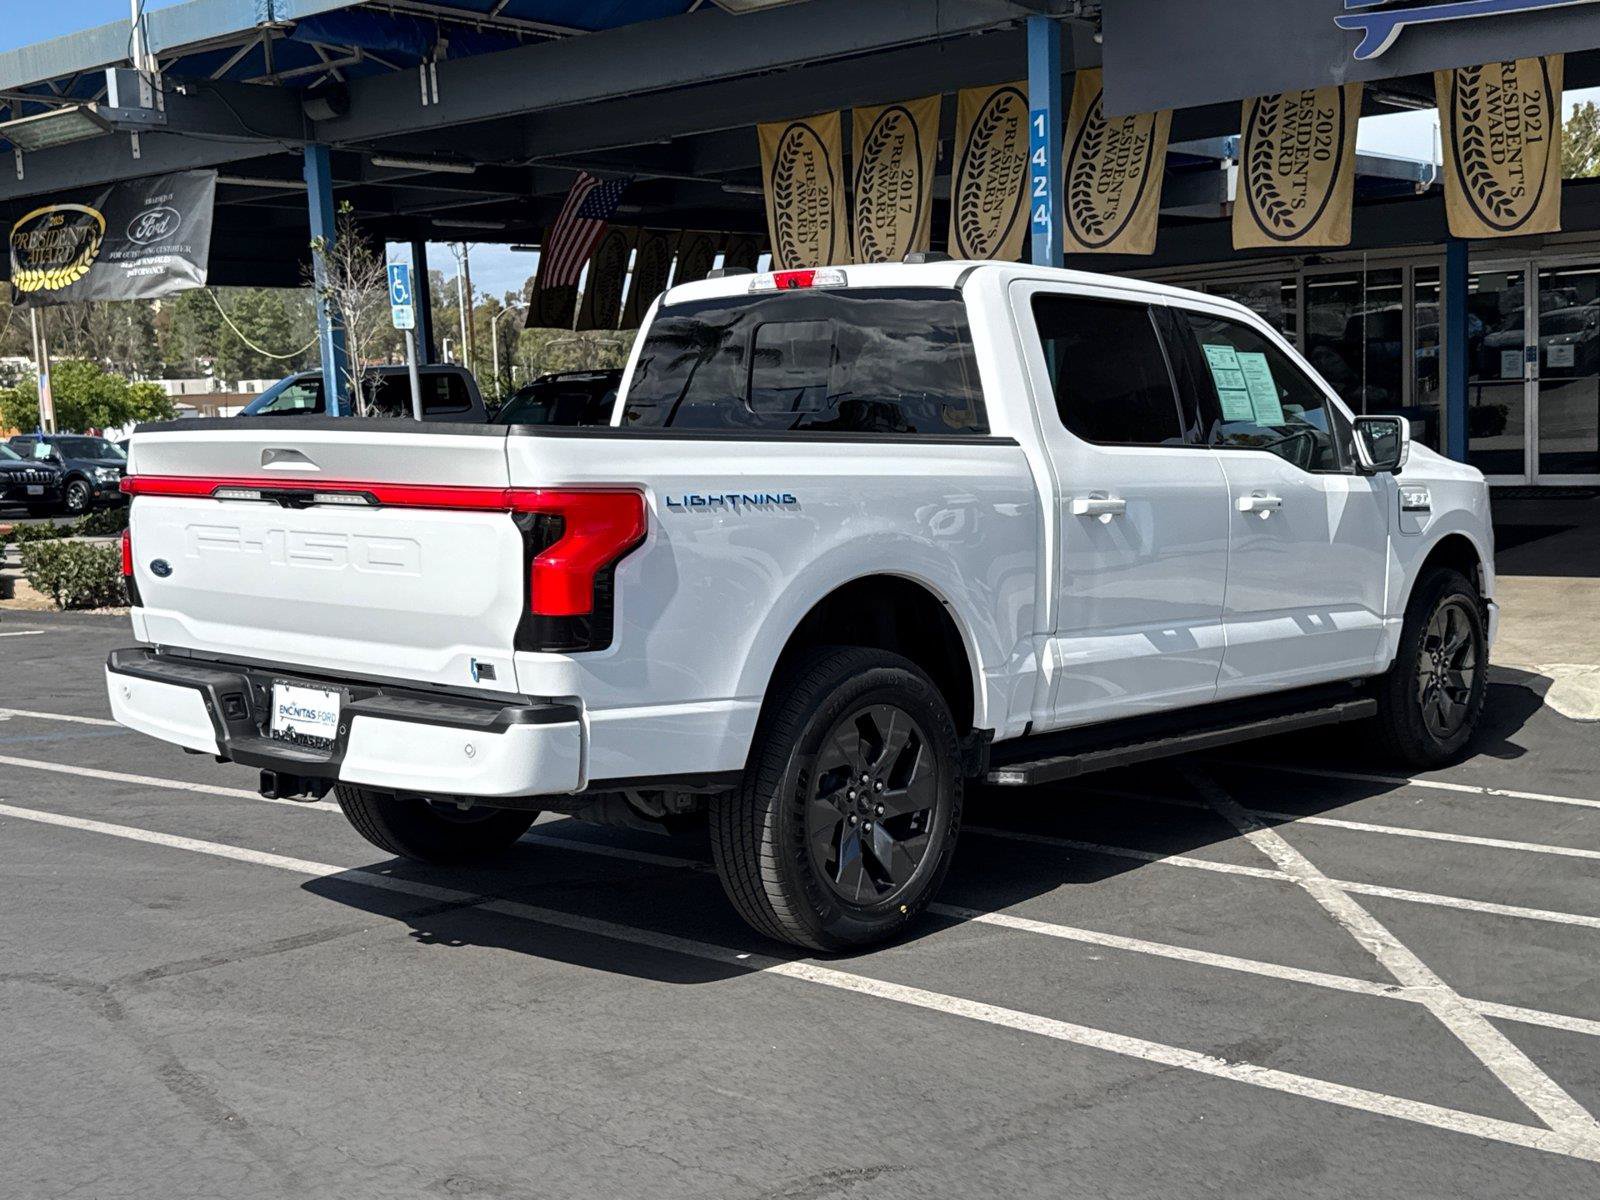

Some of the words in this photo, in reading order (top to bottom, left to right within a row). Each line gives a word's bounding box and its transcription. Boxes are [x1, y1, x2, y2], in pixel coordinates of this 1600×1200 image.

[1278, 100, 1298, 177] AWARD
[1313, 108, 1334, 161] 2020
[1485, 82, 1505, 165] AWARD
[1500, 60, 1525, 198] RESIDENT'S
[1523, 90, 1542, 144] 2021
[986, 115, 1018, 240] PRESIDENT'S
[1007, 151, 1026, 197] 2018
[1096, 128, 1121, 194] AWARD
[1103, 114, 1137, 221] RESIDENT'S
[1128, 133, 1149, 179] 2019
[1290, 89, 1315, 209] ESIDENT'S
[818, 186, 830, 230] 2016
[875, 162, 889, 229] AWARD
[885, 133, 905, 256] PRESIDENT'S
[900, 169, 914, 214] 2017
[982, 145, 1001, 213] AWARD
[14, 224, 98, 249] PRESIDENT'S
[136, 212, 171, 238] Ford
[796, 180, 808, 244] AWARD
[803, 150, 819, 268] PRESIDENT'S
[27, 245, 76, 264] AWARD
[666, 493, 797, 509] LIGHTNING
[184, 523, 422, 577] F-150
[317, 710, 337, 723] FORD
